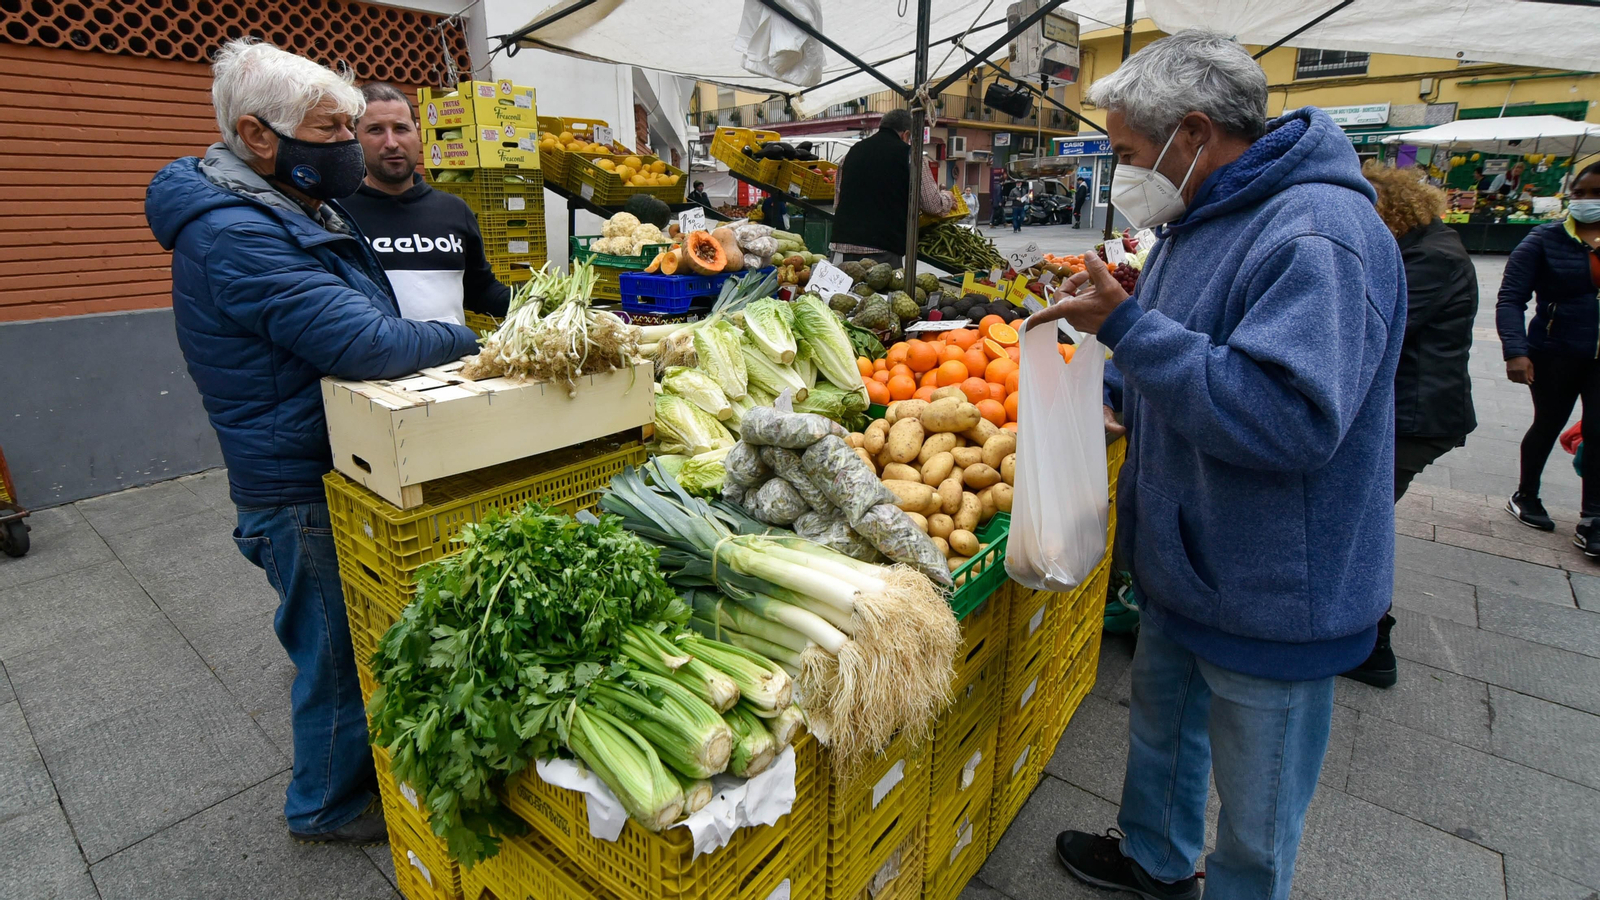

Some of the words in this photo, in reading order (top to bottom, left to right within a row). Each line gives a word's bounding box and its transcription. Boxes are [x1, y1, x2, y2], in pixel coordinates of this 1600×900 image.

[440, 108, 464, 116] ILDEFONSO
[364, 233, 464, 253] eebok
[1012, 288, 1024, 299] FRESAS
